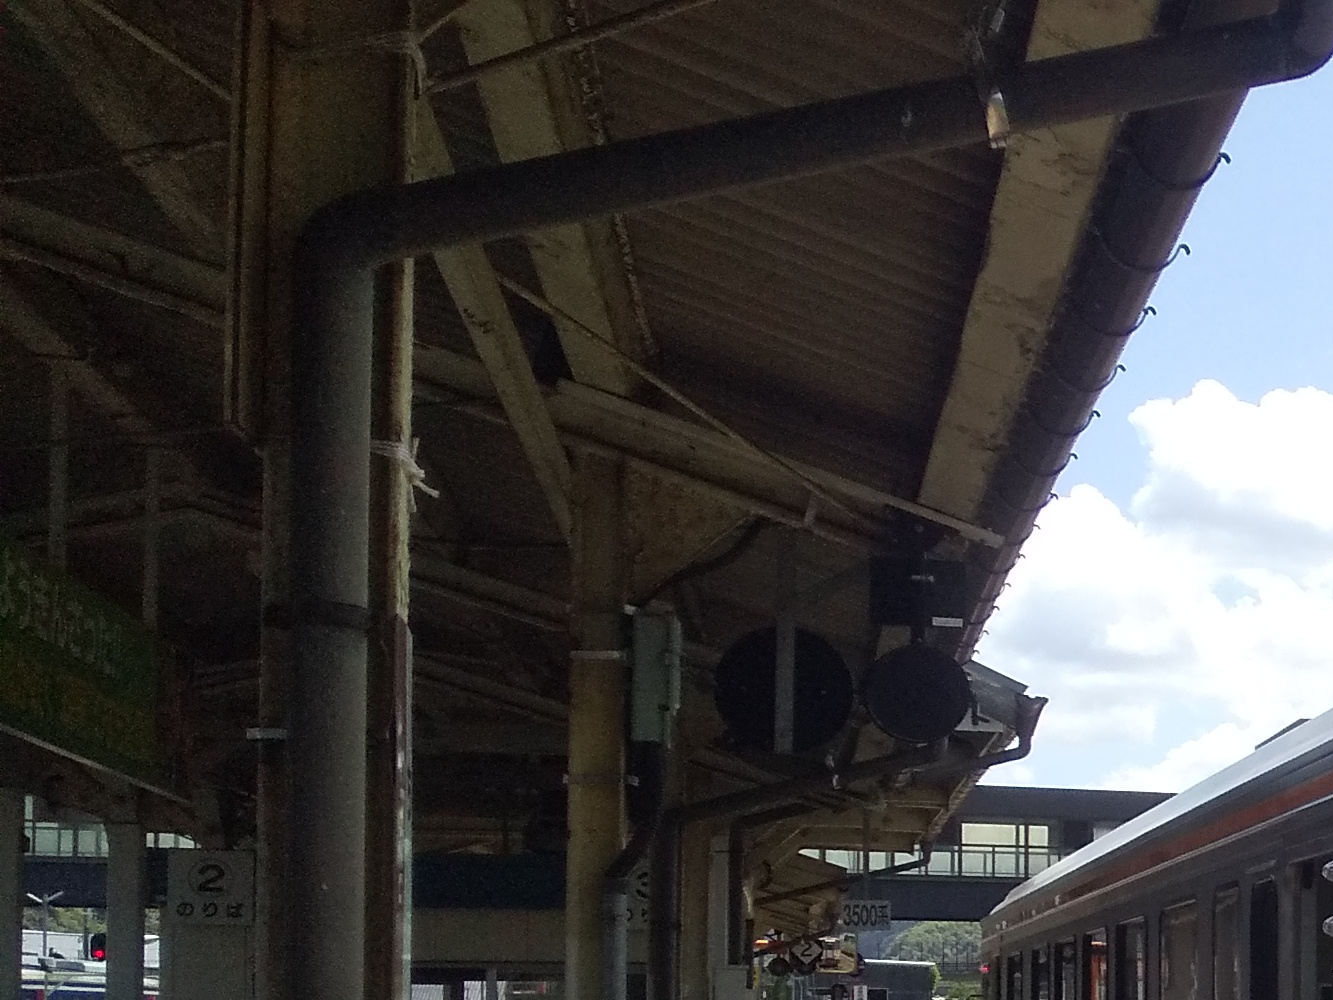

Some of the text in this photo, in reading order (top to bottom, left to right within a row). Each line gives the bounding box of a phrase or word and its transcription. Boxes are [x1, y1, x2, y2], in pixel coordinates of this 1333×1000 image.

[176, 902, 245, 918] のりば
[801, 942, 812, 957] 2
